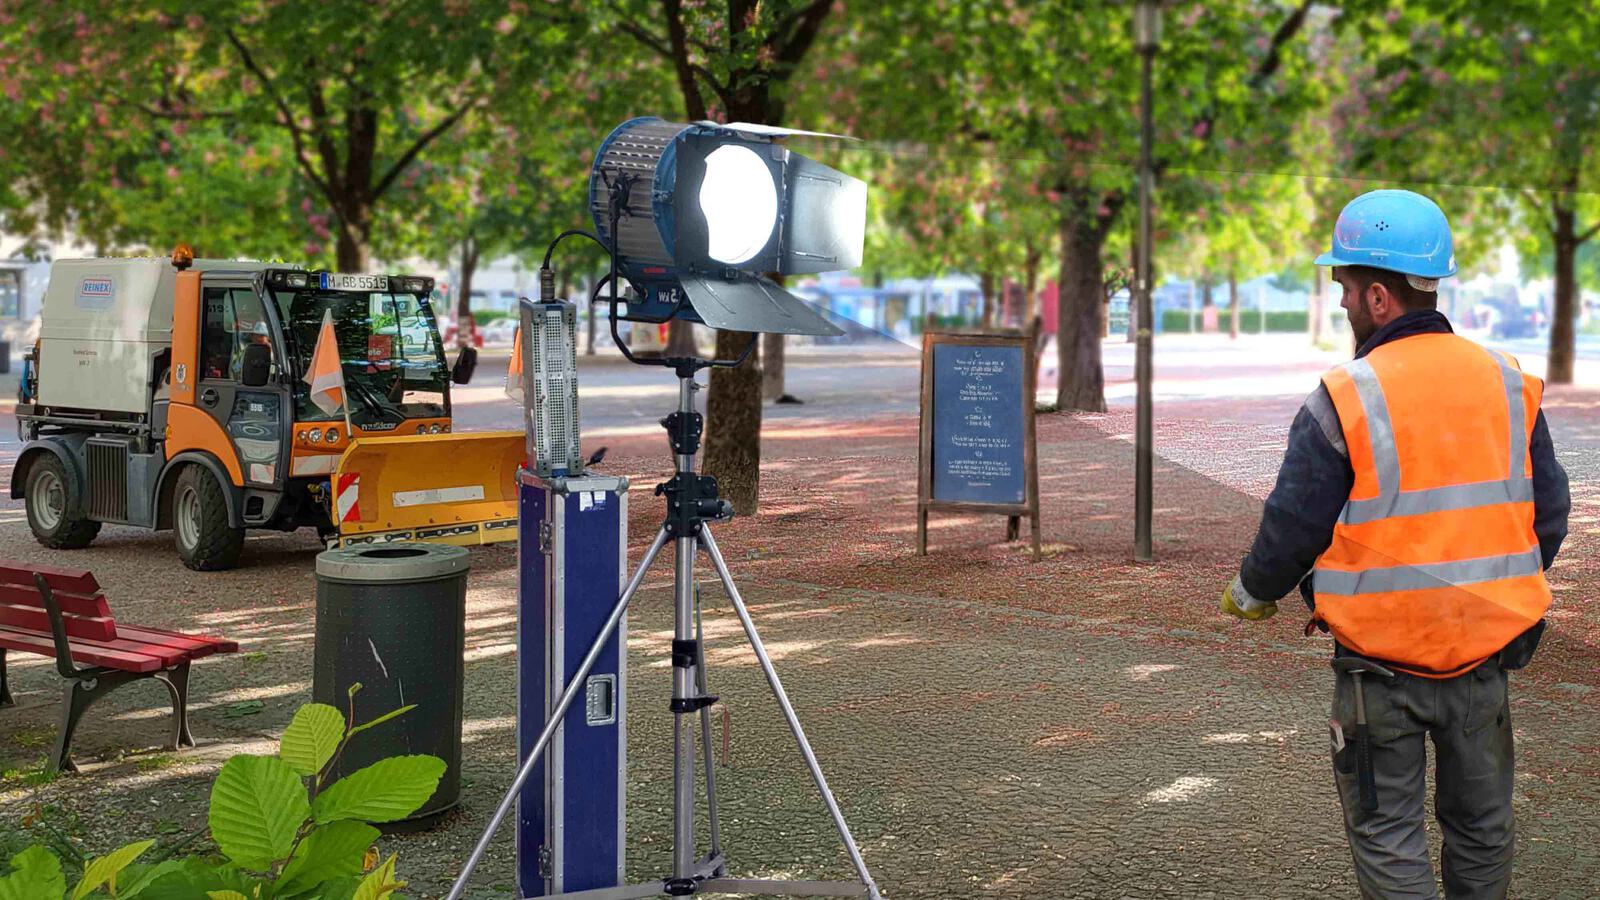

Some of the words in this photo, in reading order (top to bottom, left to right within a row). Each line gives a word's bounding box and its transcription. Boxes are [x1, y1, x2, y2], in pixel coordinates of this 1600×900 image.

[84, 283, 110, 293] REINEX
[328, 276, 336, 288] M
[359, 277, 387, 289] 5515
